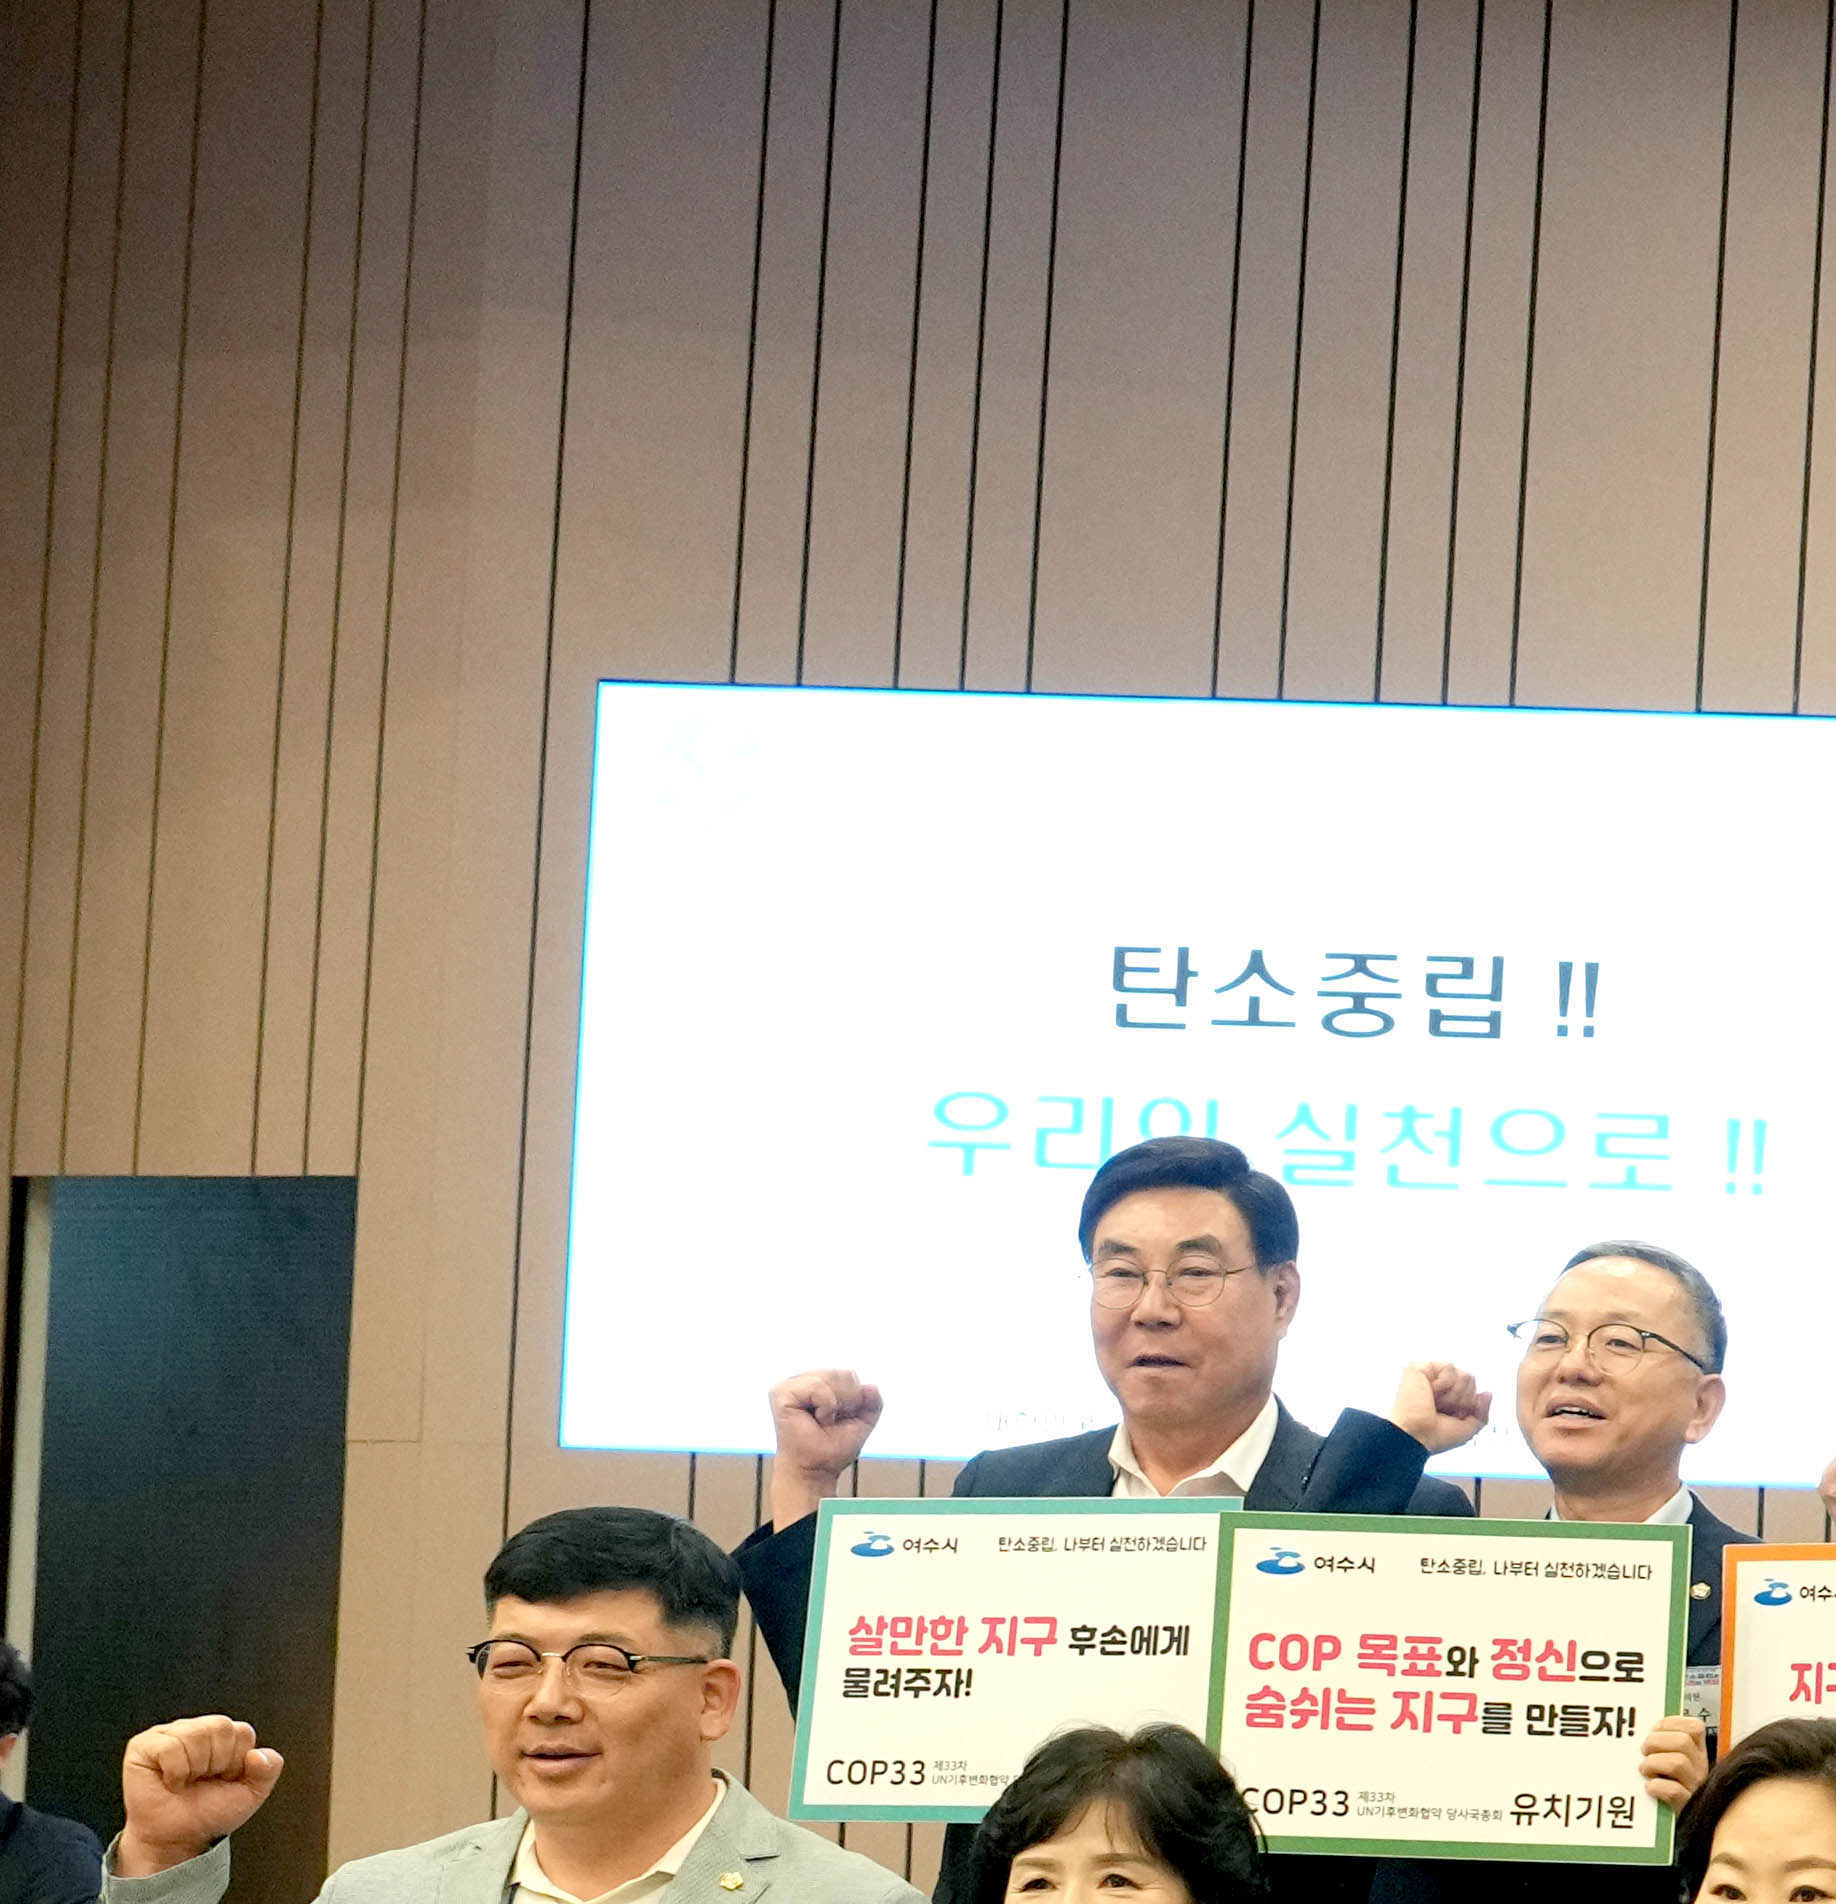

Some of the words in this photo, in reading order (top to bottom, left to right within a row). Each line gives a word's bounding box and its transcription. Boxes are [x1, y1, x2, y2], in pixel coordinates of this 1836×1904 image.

[1113, 947, 1504, 1039] 탄소중립
[1263, 1102, 1672, 1198] 실천으로
[1314, 1556, 1375, 1573] 여수시
[849, 1616, 968, 1656] 살만한
[978, 1616, 1057, 1656] 지구
[1068, 1624, 1190, 1656] 후손에게
[1249, 1633, 1341, 1671] COP
[1357, 1634, 1479, 1678] 목표와
[1491, 1638, 1644, 1683] 정신으로
[843, 1668, 972, 1698] 물려주자!
[1245, 1685, 1376, 1731] 숨쉬는
[1391, 1691, 1512, 1735] 지구를
[1526, 1704, 1636, 1738] 만들자!
[827, 1760, 925, 1785] COP33
[1510, 1793, 1634, 1829] 유치기원
